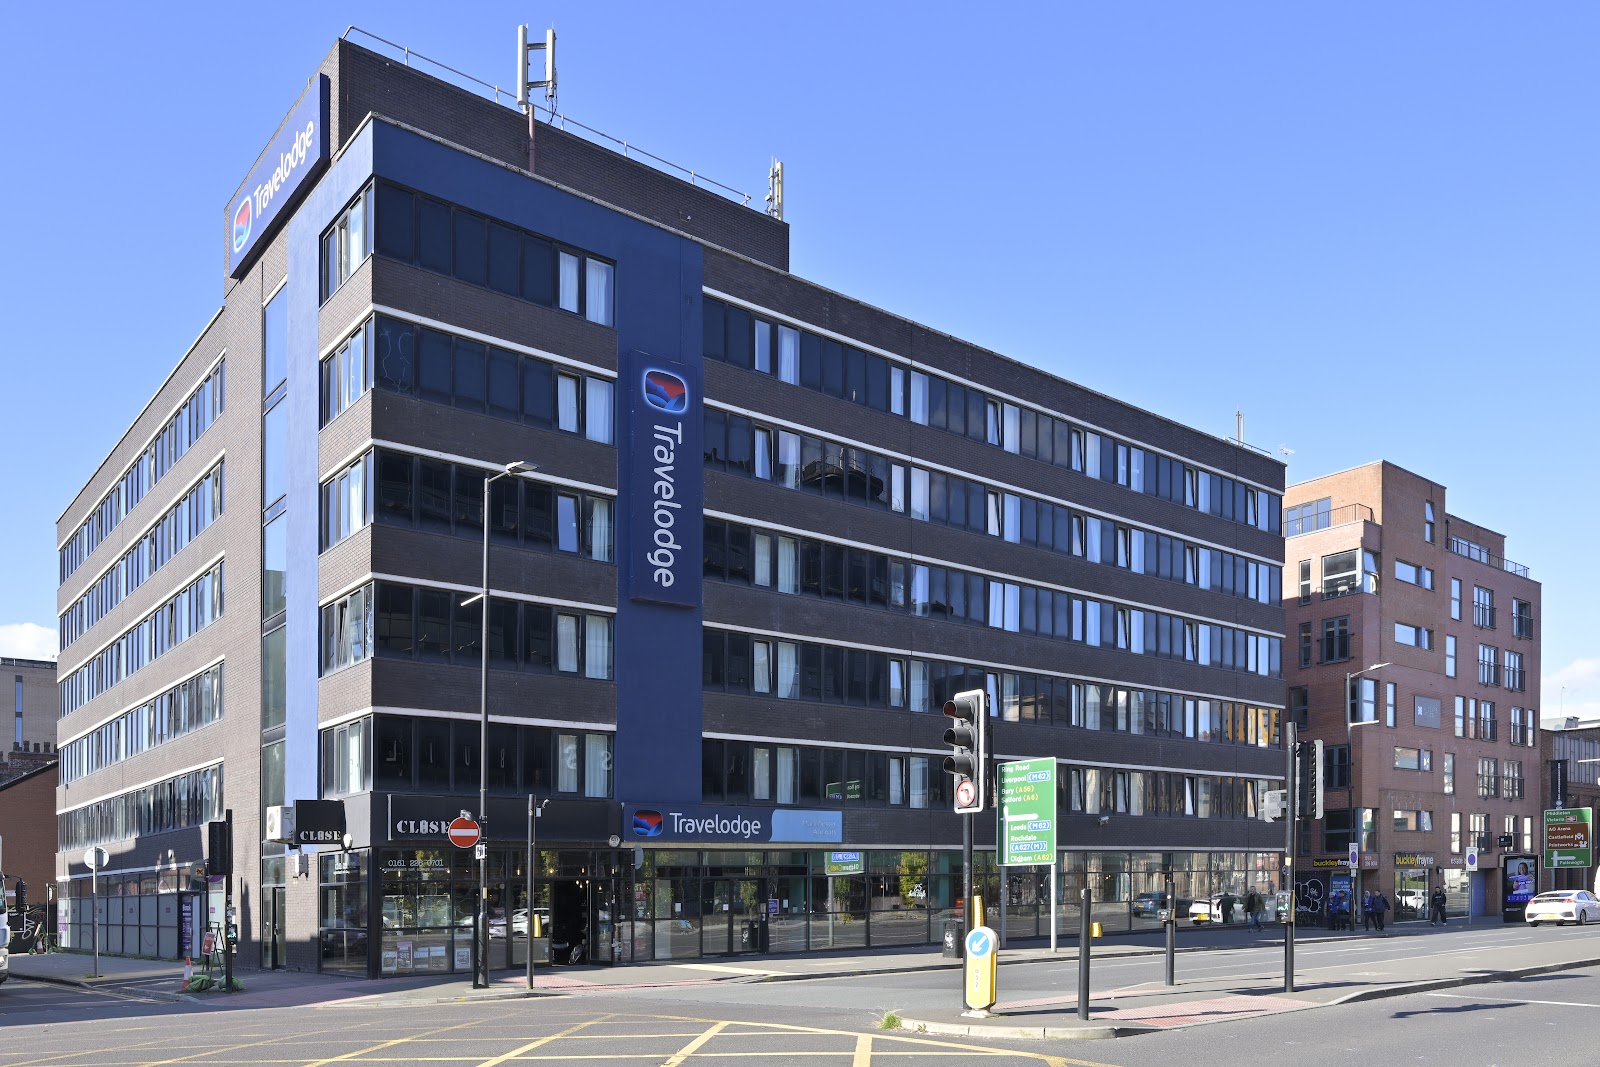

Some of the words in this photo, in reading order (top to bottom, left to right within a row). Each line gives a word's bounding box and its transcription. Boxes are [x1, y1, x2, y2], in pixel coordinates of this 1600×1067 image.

[253, 120, 314, 219] Travelodge
[646, 421, 682, 588] Travelodge
[1001, 775, 1027, 784] Liverpool
[396, 820, 450, 834] CLOSE
[669, 812, 762, 839] Travelodge
[299, 830, 342, 841] CLOSE
[388, 859, 406, 867] 0161
[1010, 854, 1033, 862] Oldham
[1313, 859, 1350, 867] buckleyfray
[1395, 854, 1434, 866] buckleyfrayne
